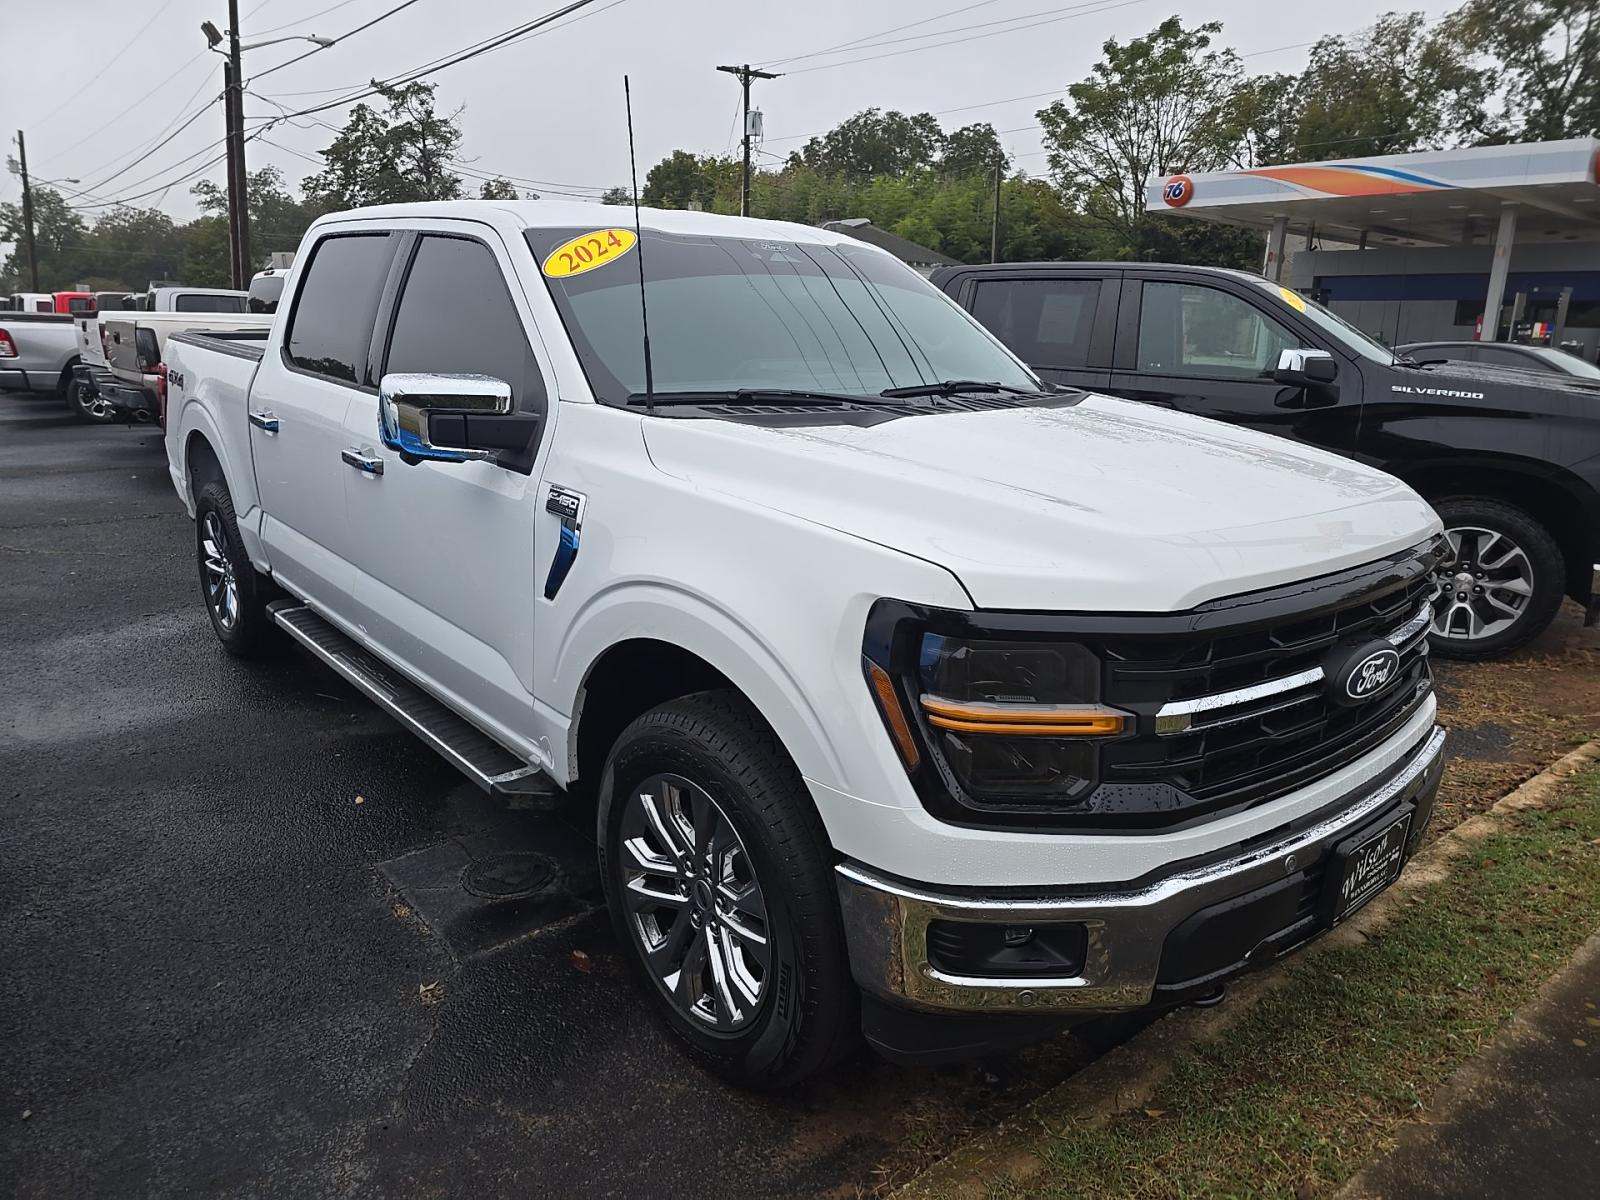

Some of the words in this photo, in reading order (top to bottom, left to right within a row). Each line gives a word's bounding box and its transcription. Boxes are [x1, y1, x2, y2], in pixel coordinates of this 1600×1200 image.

[1165, 181, 1185, 199] 76
[559, 231, 622, 272] 2024
[1391, 385, 1484, 399] SILVERADO
[1357, 657, 1392, 693] Ford
[1342, 834, 1388, 900] Wilson
